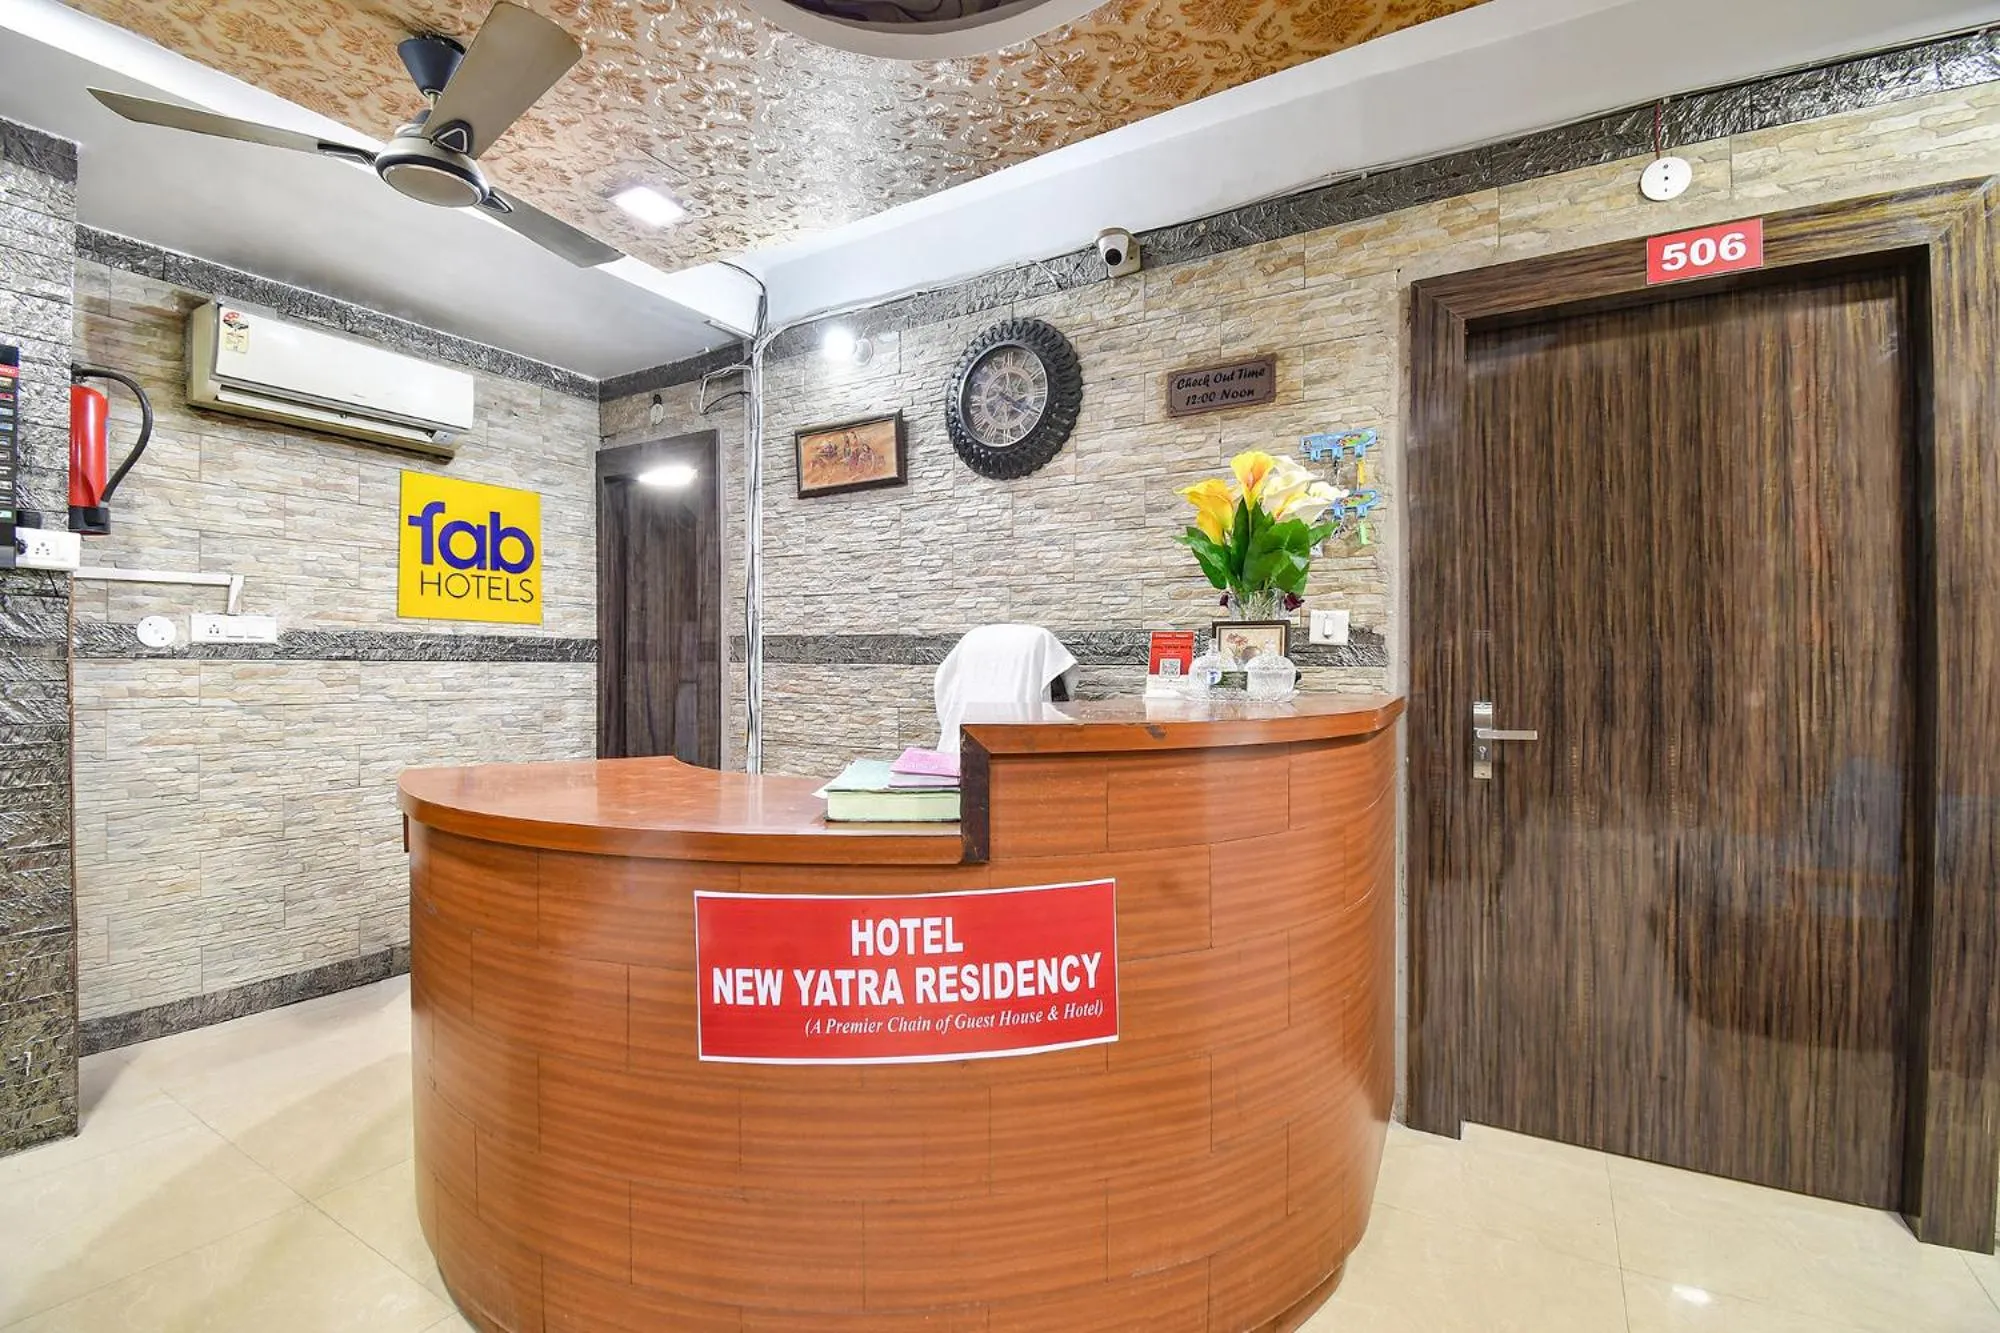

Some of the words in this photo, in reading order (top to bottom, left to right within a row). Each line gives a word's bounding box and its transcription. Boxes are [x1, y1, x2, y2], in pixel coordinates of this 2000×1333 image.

[1661, 232, 1747, 272] 506
[1176, 373, 1210, 390] Check
[1213, 371, 1235, 384] Out
[1237, 367, 1265, 380] Time
[1185, 391, 1217, 406] 12:00
[1220, 388, 1255, 401] Noon
[408, 501, 535, 574] fab
[420, 570, 534, 603] HOTELS
[850, 916, 964, 957] HOTEL
[712, 967, 784, 1006] NEW
[792, 967, 905, 1007] YATRA
[915, 952, 1103, 1005] RESIDENCY
[804, 1018, 822, 1036] (A
[825, 1017, 883, 1035] Premier
[886, 1015, 932, 1032] Chain
[935, 1014, 951, 1034] of
[956, 1012, 996, 1030] Guest
[999, 1008, 1043, 1026] House
[1047, 1005, 1059, 1021] &
[1063, 1000, 1103, 1019] Hotel)
